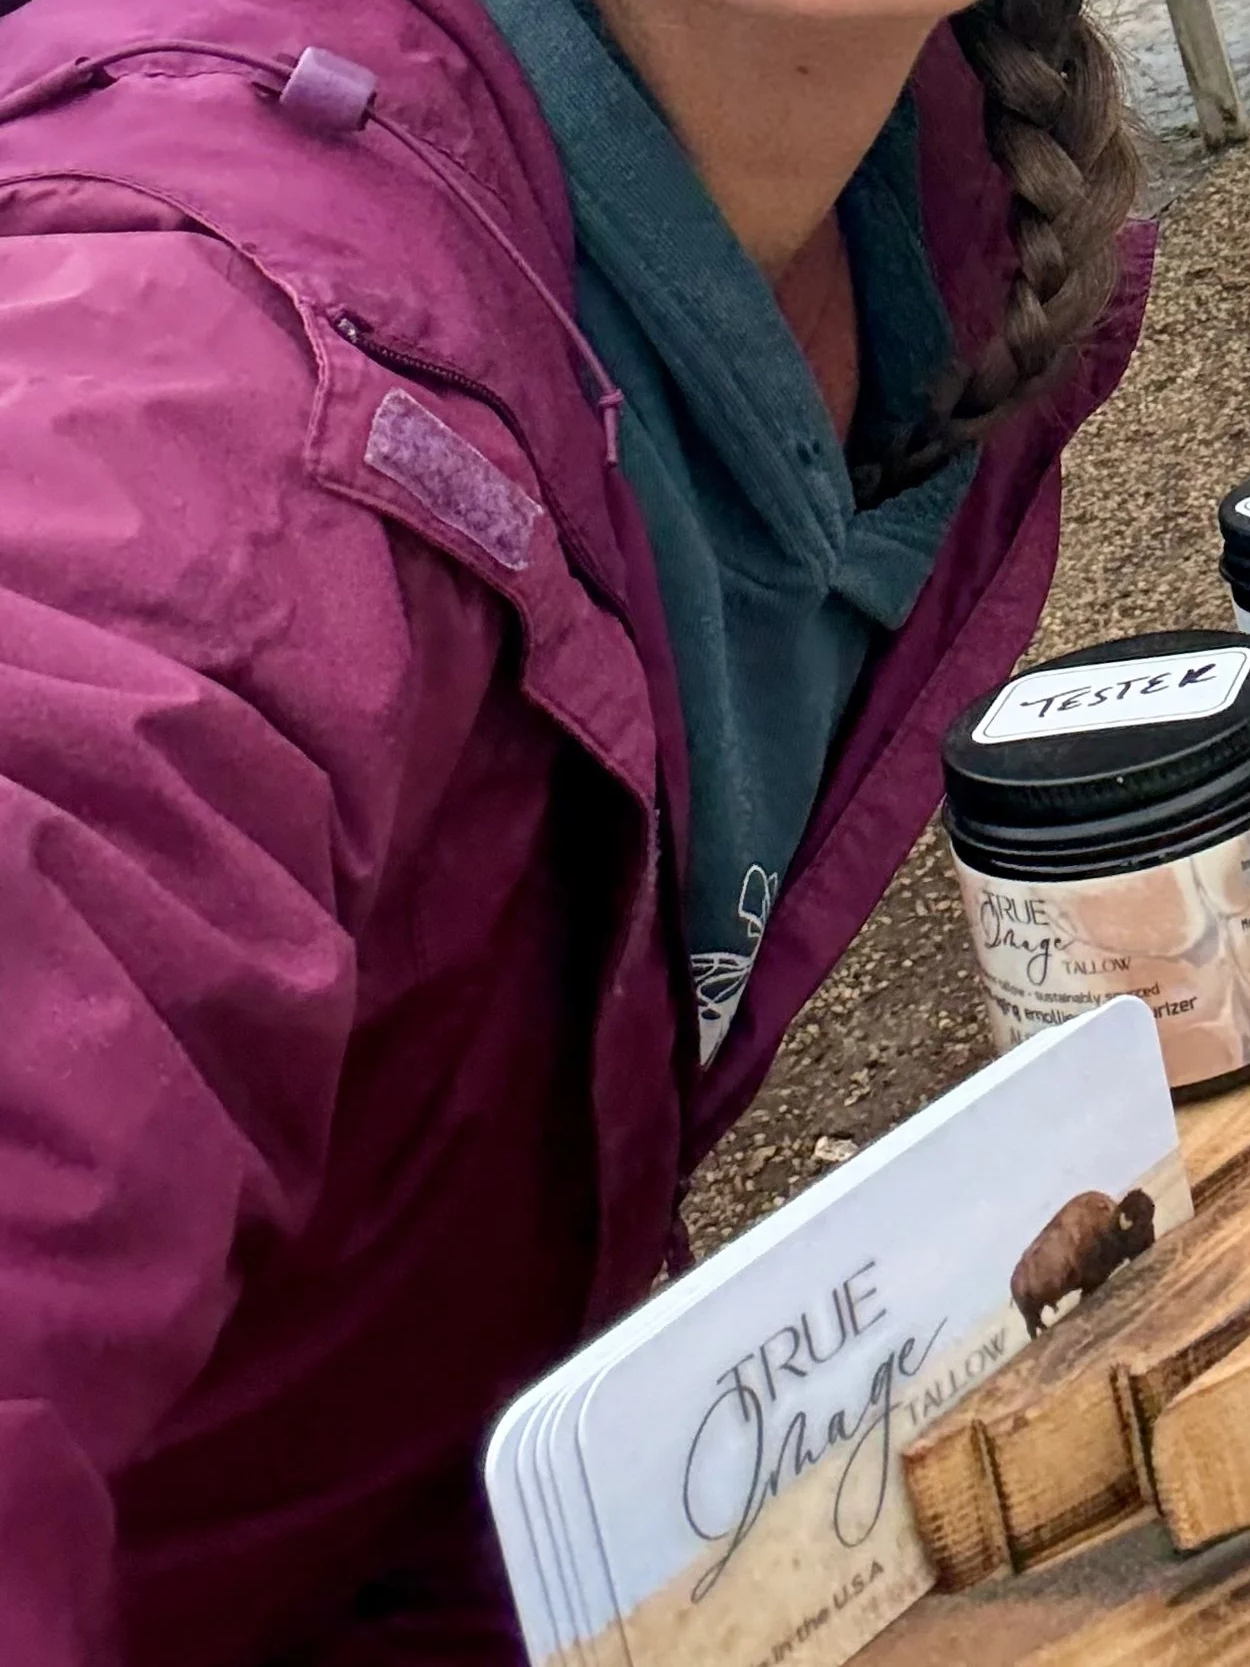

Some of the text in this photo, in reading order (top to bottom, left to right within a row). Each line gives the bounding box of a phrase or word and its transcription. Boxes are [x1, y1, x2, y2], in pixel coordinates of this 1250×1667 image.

[1019, 663, 1219, 720] TESTER
[982, 891, 1050, 926] TRUE
[1061, 957, 1132, 976] TALLOW
[716, 1262, 888, 1422] TRUE
[903, 1328, 1010, 1426] TALLOW
[797, 1608, 830, 1643] the
[832, 1559, 885, 1610] U.S.A
